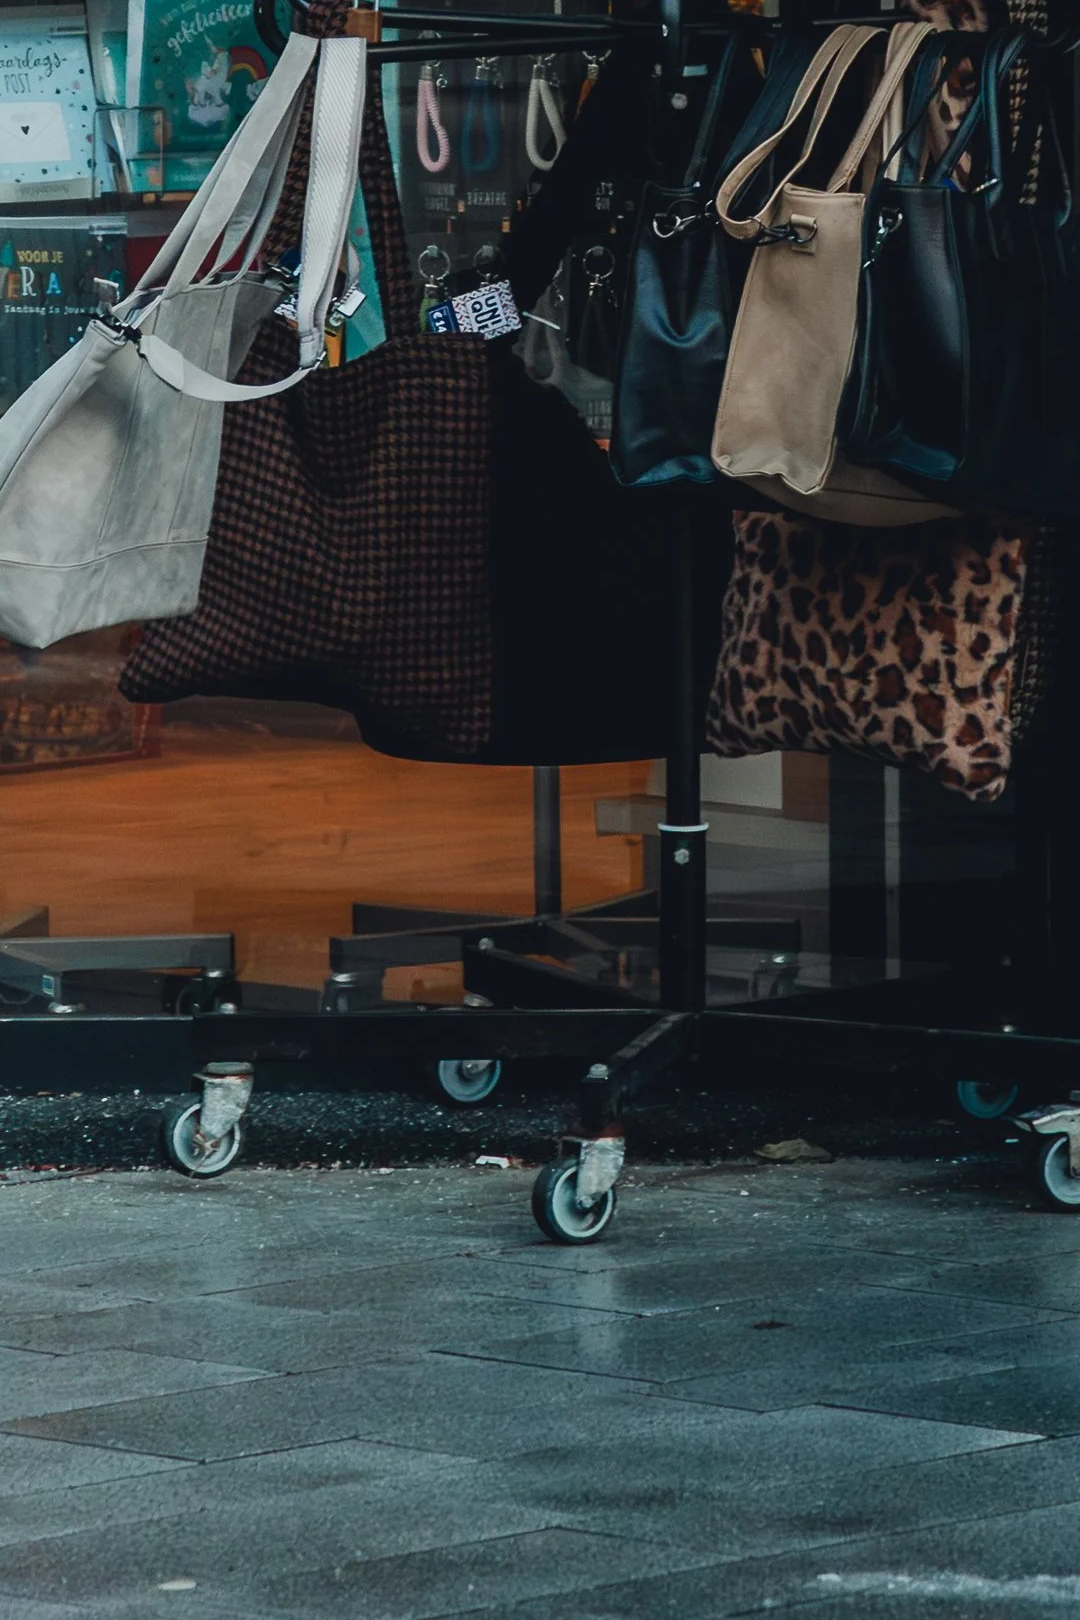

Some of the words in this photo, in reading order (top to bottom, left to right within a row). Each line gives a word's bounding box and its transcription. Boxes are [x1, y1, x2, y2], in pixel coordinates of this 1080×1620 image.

[167, 4, 254, 57] gefeliciteer
[4, 73, 32, 94] POST
[17, 250, 49, 263] VOOR
[51, 251, 64, 263] JE
